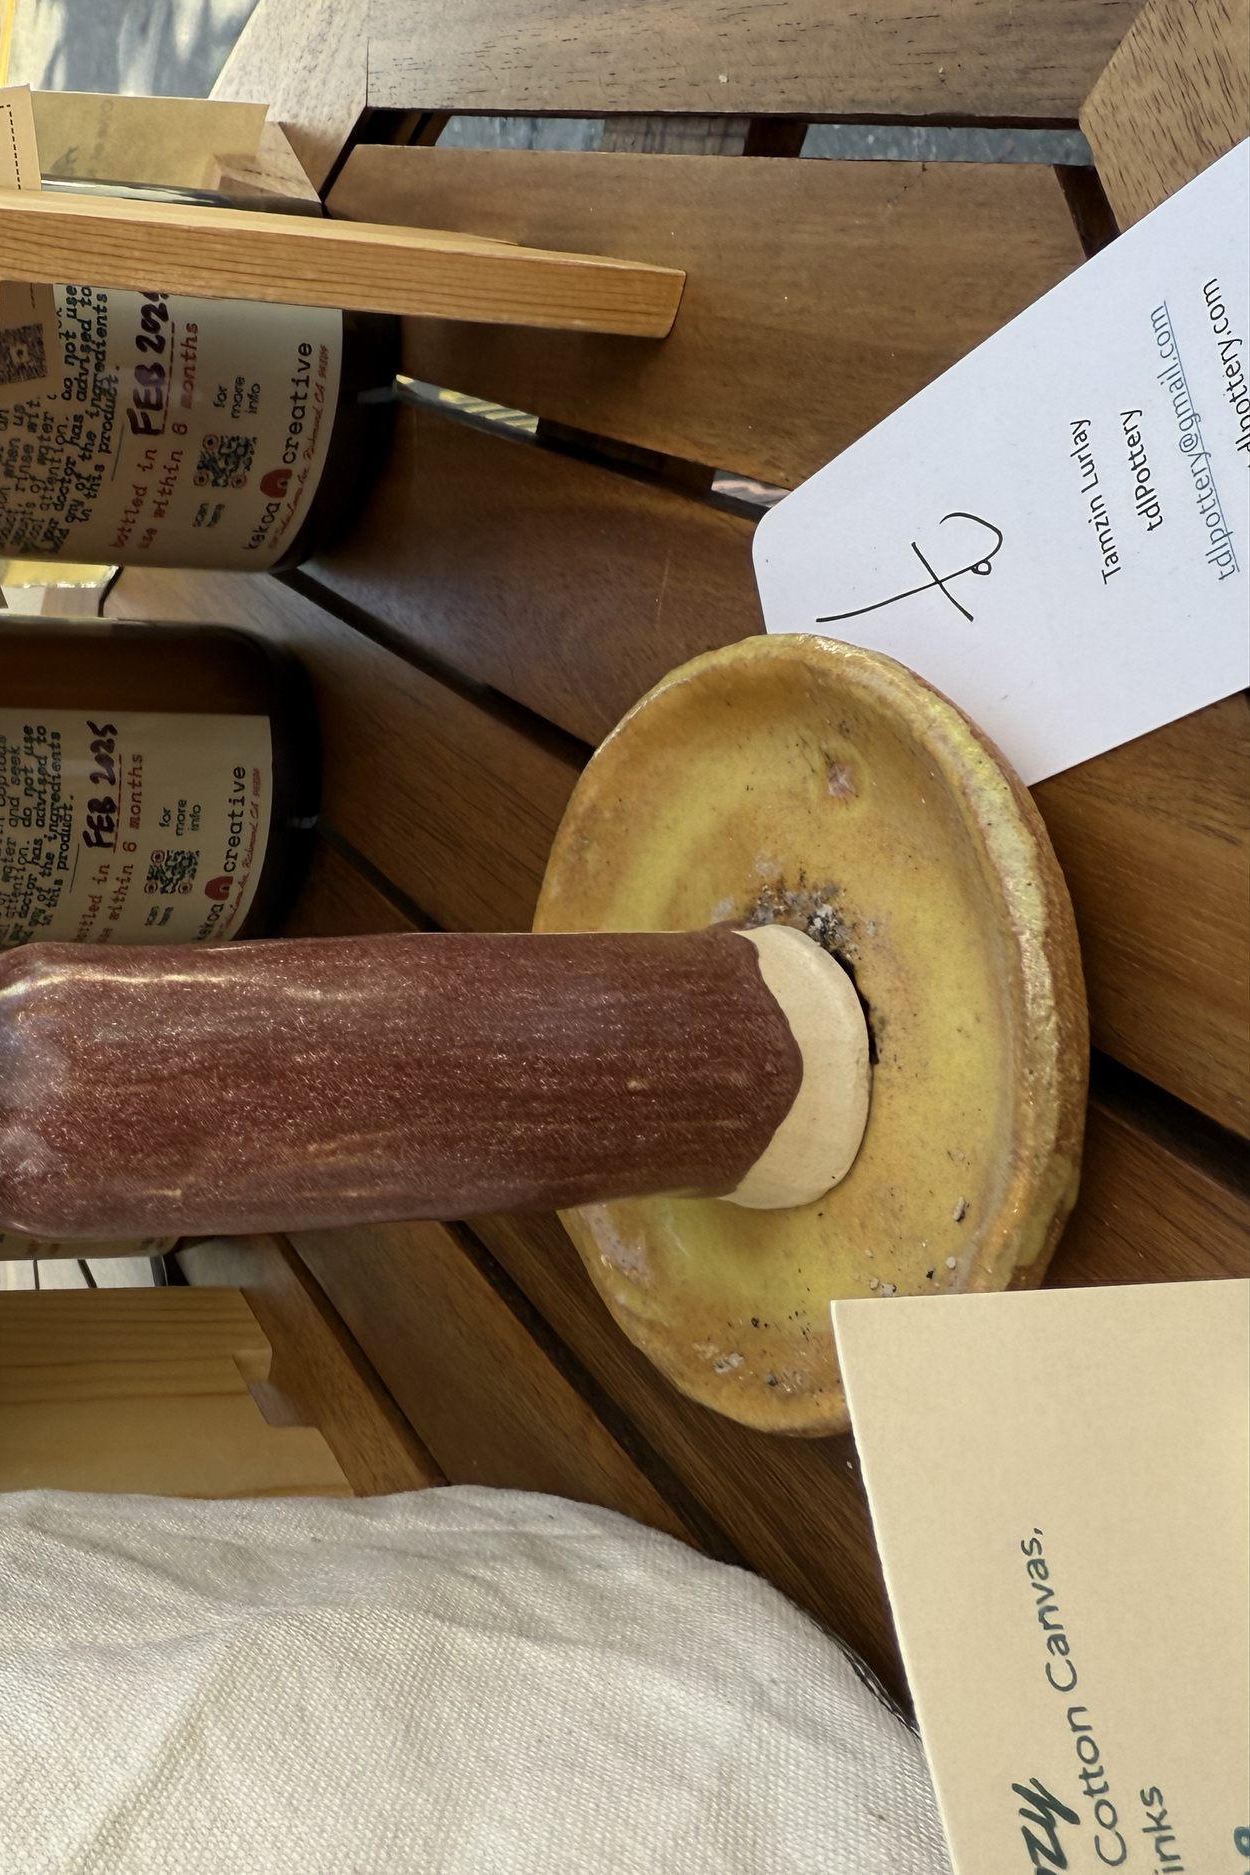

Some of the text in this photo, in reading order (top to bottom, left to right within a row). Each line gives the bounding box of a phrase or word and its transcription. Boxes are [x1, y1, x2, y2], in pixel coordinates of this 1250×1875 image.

[126, 362, 166, 436] FEB
[180, 323, 199, 409] months
[280, 342, 313, 464] creative
[137, 449, 157, 472] in
[1116, 407, 1164, 531] tdlPottery
[1148, 304, 1238, 580] tdlpottery@gmail.com
[1067, 417, 1122, 585] Tamzin Lurlay
[31, 755, 48, 828] advised
[45, 731, 62, 842] ingredients
[82, 720, 118, 884] in FEB 2025
[126, 754, 143, 829] months
[160, 808, 171, 827] for
[176, 799, 187, 836] more
[222, 767, 246, 873] creative
[1019, 1526, 1127, 1867] Cotton Canvas,
